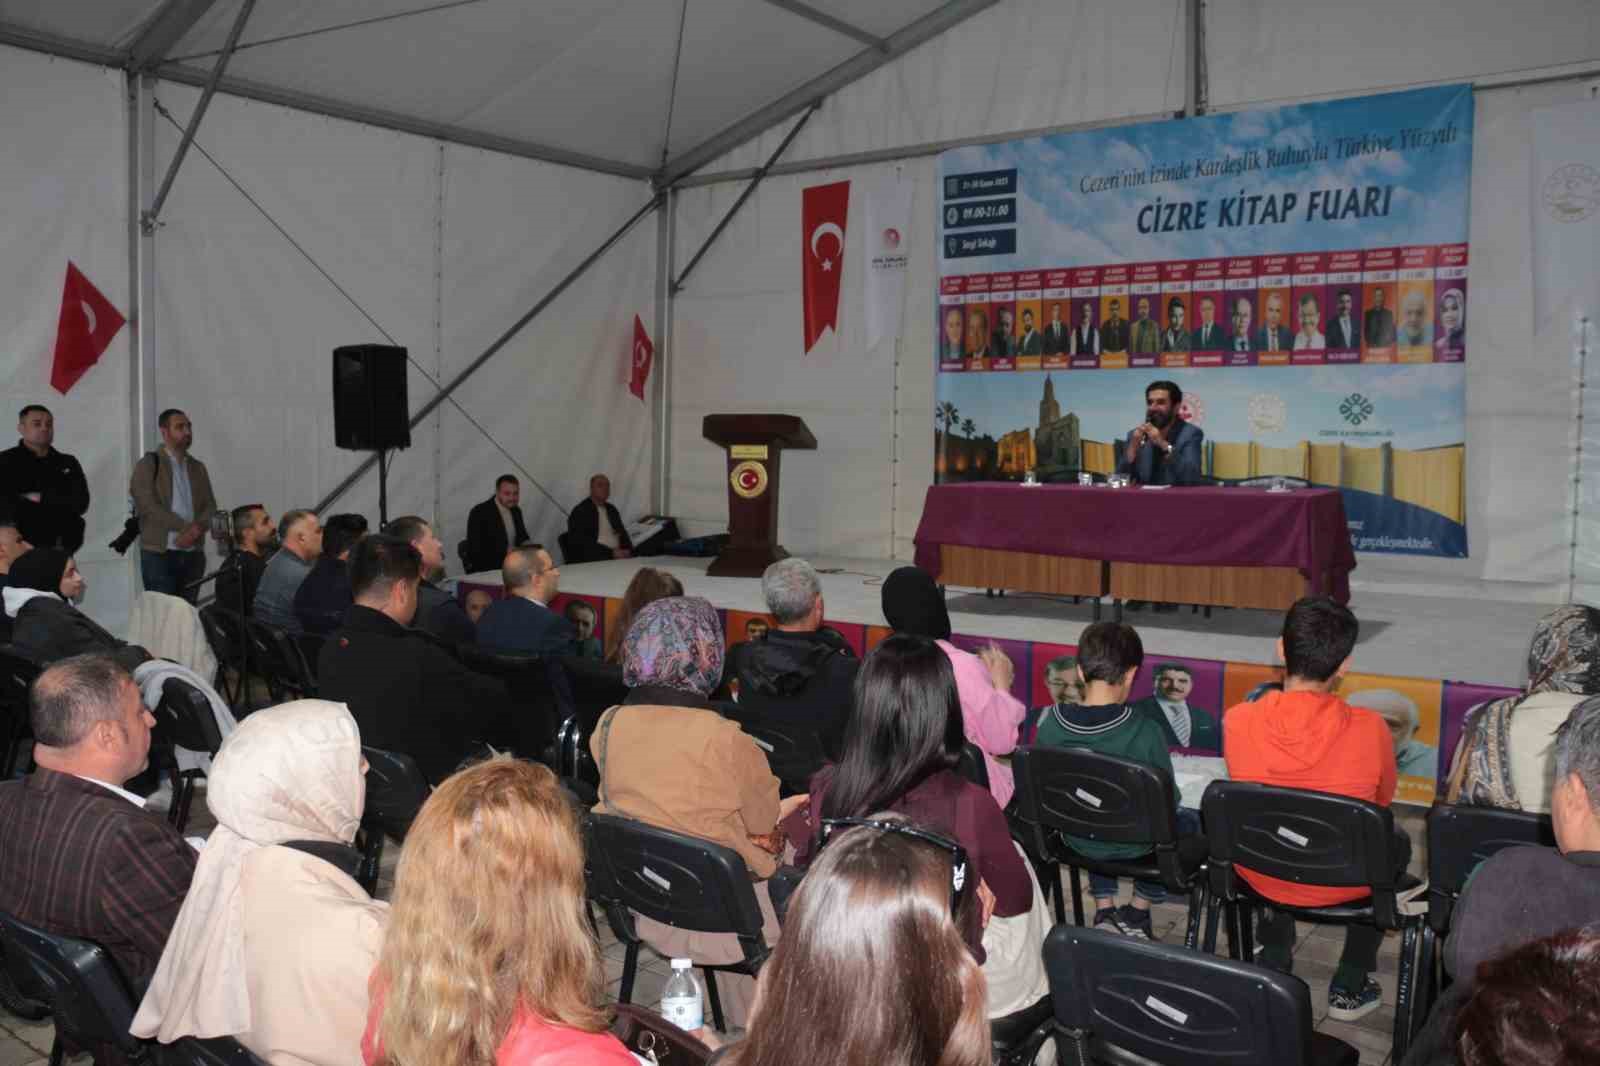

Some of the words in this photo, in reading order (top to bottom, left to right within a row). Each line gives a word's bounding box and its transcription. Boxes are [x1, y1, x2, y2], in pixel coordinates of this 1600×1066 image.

[1195, 151, 1261, 178] Kardeşlik
[1266, 140, 1328, 169] Ruhuyla
[1335, 133, 1393, 160] Türkiye
[1137, 195, 1209, 234] CİZRE
[1217, 189, 1297, 228] KİTAP
[1306, 185, 1394, 222] FUARI
